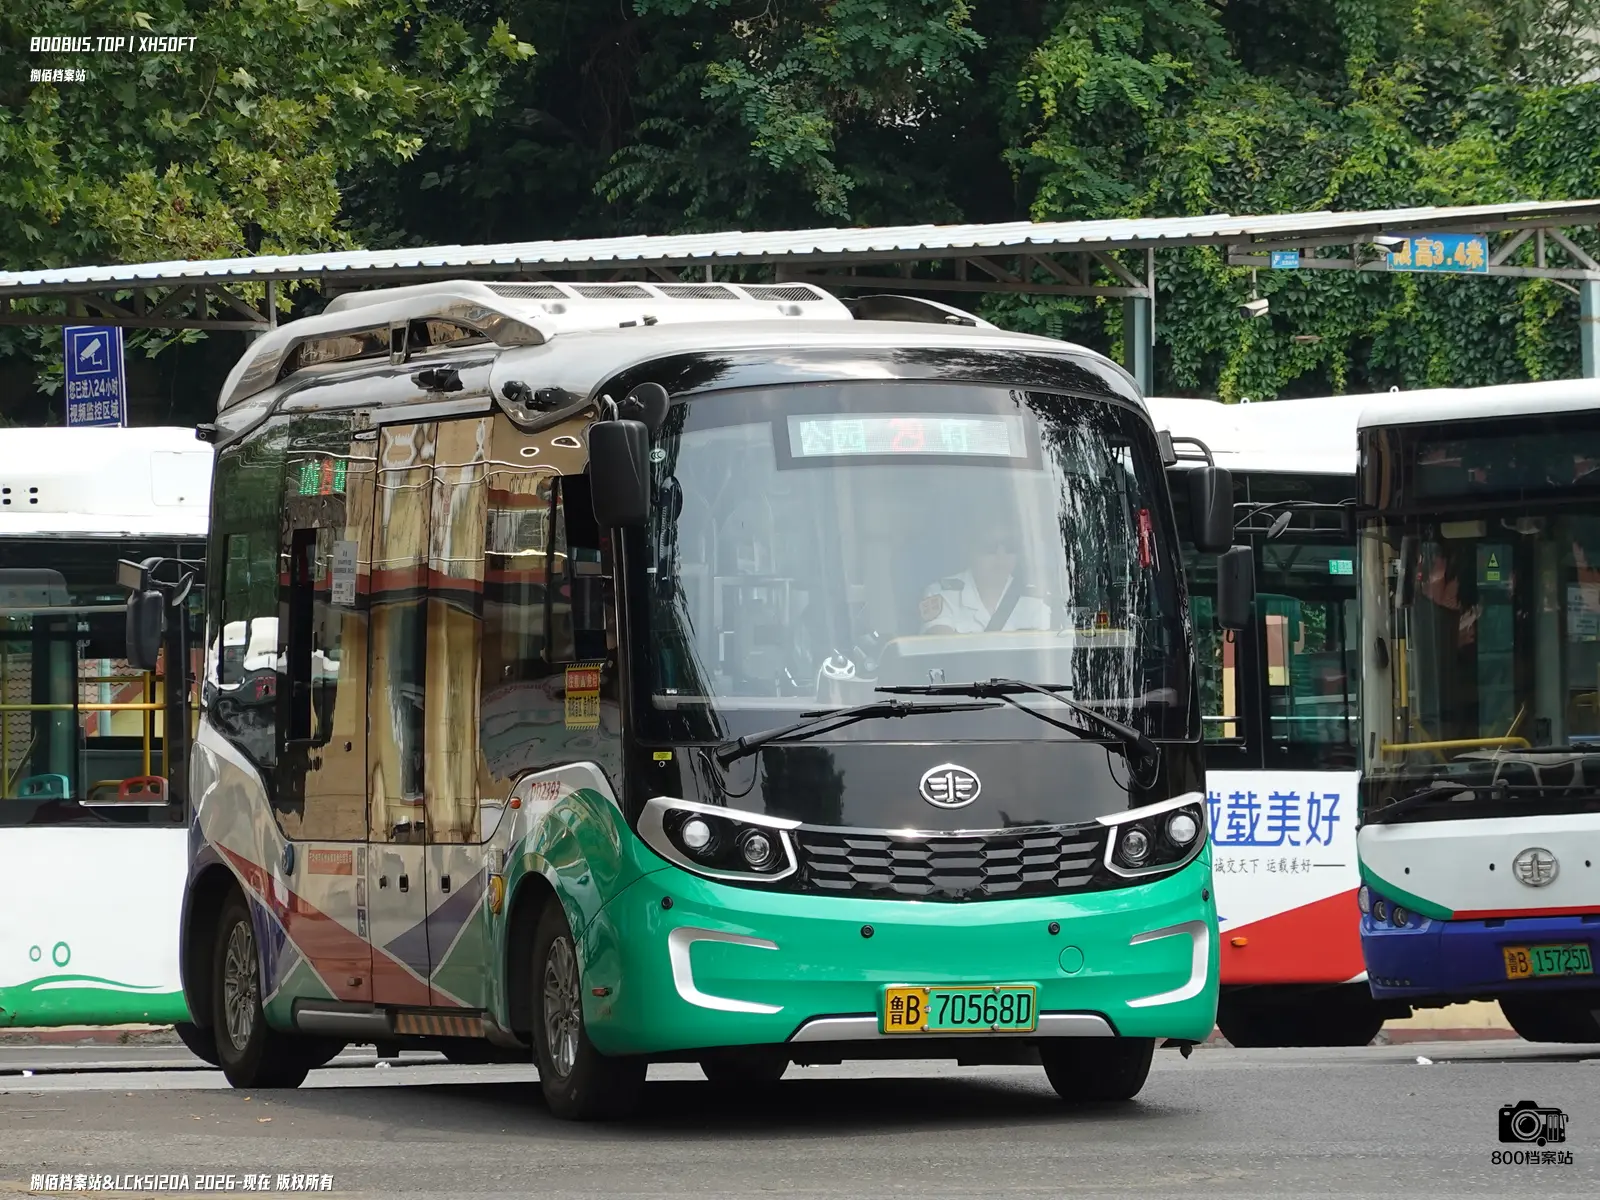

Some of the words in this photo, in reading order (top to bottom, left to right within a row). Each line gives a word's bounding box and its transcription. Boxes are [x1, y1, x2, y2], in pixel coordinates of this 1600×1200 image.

[69, 377, 118, 399] 您已进入24小时
[70, 400, 119, 423] 视频监控区域
[1214, 858, 1259, 874] 诚交天下
[1266, 858, 1312, 874] 运载美好
[1536, 949, 1590, 972] 15725D
[889, 995, 921, 1026] 鲁B
[935, 993, 1031, 1025] 70568D
